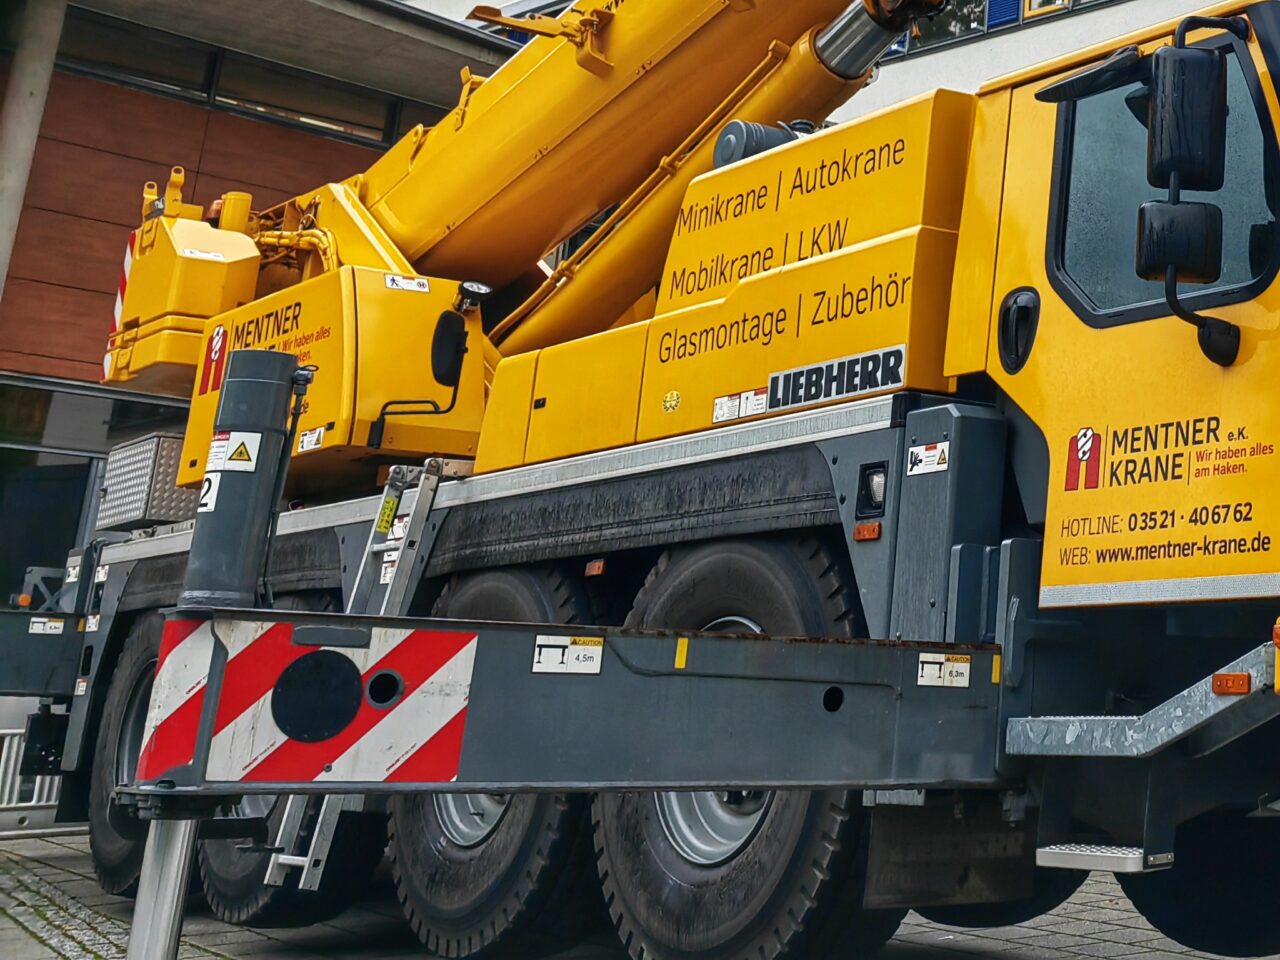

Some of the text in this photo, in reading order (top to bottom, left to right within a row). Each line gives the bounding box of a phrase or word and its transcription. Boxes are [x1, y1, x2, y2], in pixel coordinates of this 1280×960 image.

[677, 138, 905, 237] Minikrane Autokrane
[669, 217, 849, 299] Mobilkrane LKW
[233, 302, 301, 350] MENTNER
[659, 274, 912, 363] Glasmontage Zubehör
[769, 349, 903, 409] LIEBHERR
[1111, 416, 1249, 456] MENTNER e.K.
[1195, 443, 1274, 463] Wir haben alles
[1109, 452, 1184, 487] KRANE
[1194, 462, 1248, 478] am Haken.
[199, 477, 212, 508] 2
[1061, 515, 1123, 538] HOTLINE:
[1059, 531, 1271, 566] WEB: www.mentner-krane.de
[575, 654, 594, 663] 4,5m
[948, 670, 964, 678] 6,3m
